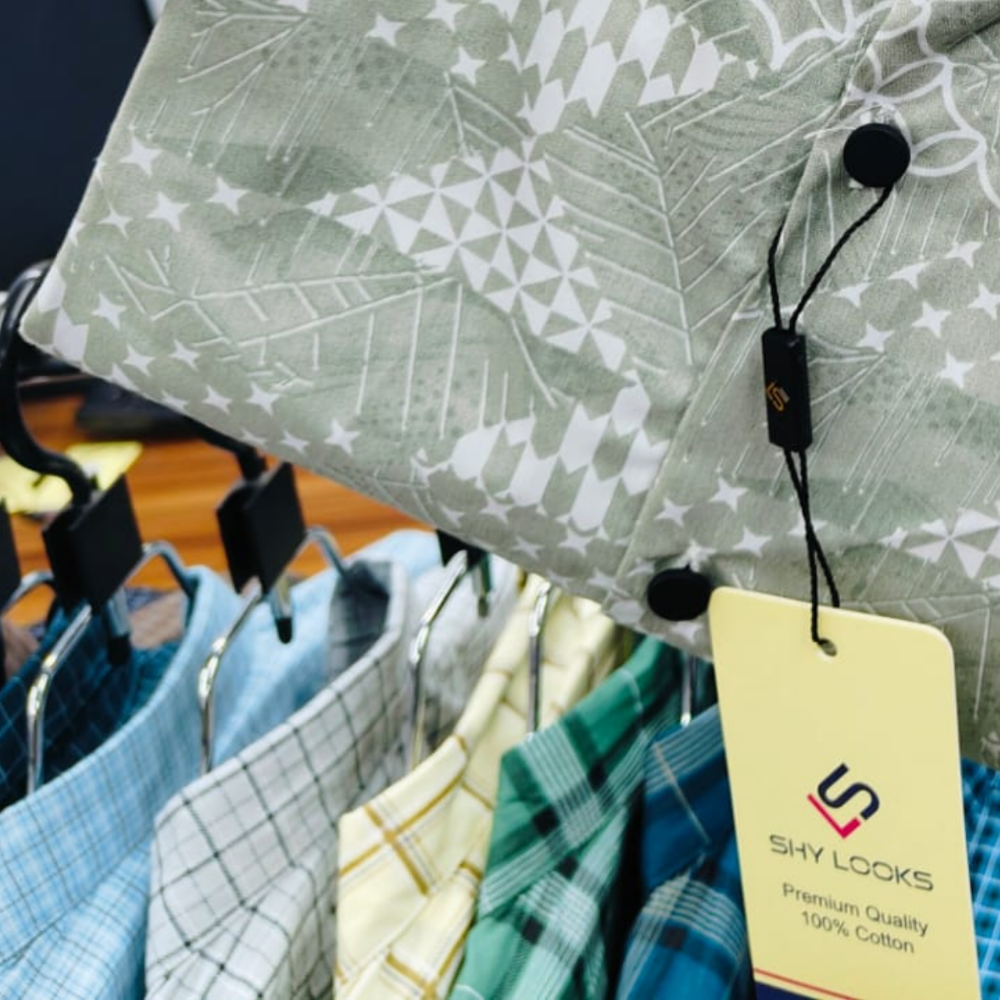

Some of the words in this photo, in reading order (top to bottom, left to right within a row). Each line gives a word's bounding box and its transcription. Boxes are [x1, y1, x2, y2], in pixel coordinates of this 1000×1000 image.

[769, 834, 824, 863] SHY
[833, 850, 935, 892] LOOKS
[782, 882, 861, 917] Premium
[865, 904, 929, 937] Quality
[801, 910, 850, 937] 100%
[855, 926, 915, 954] Cotton
